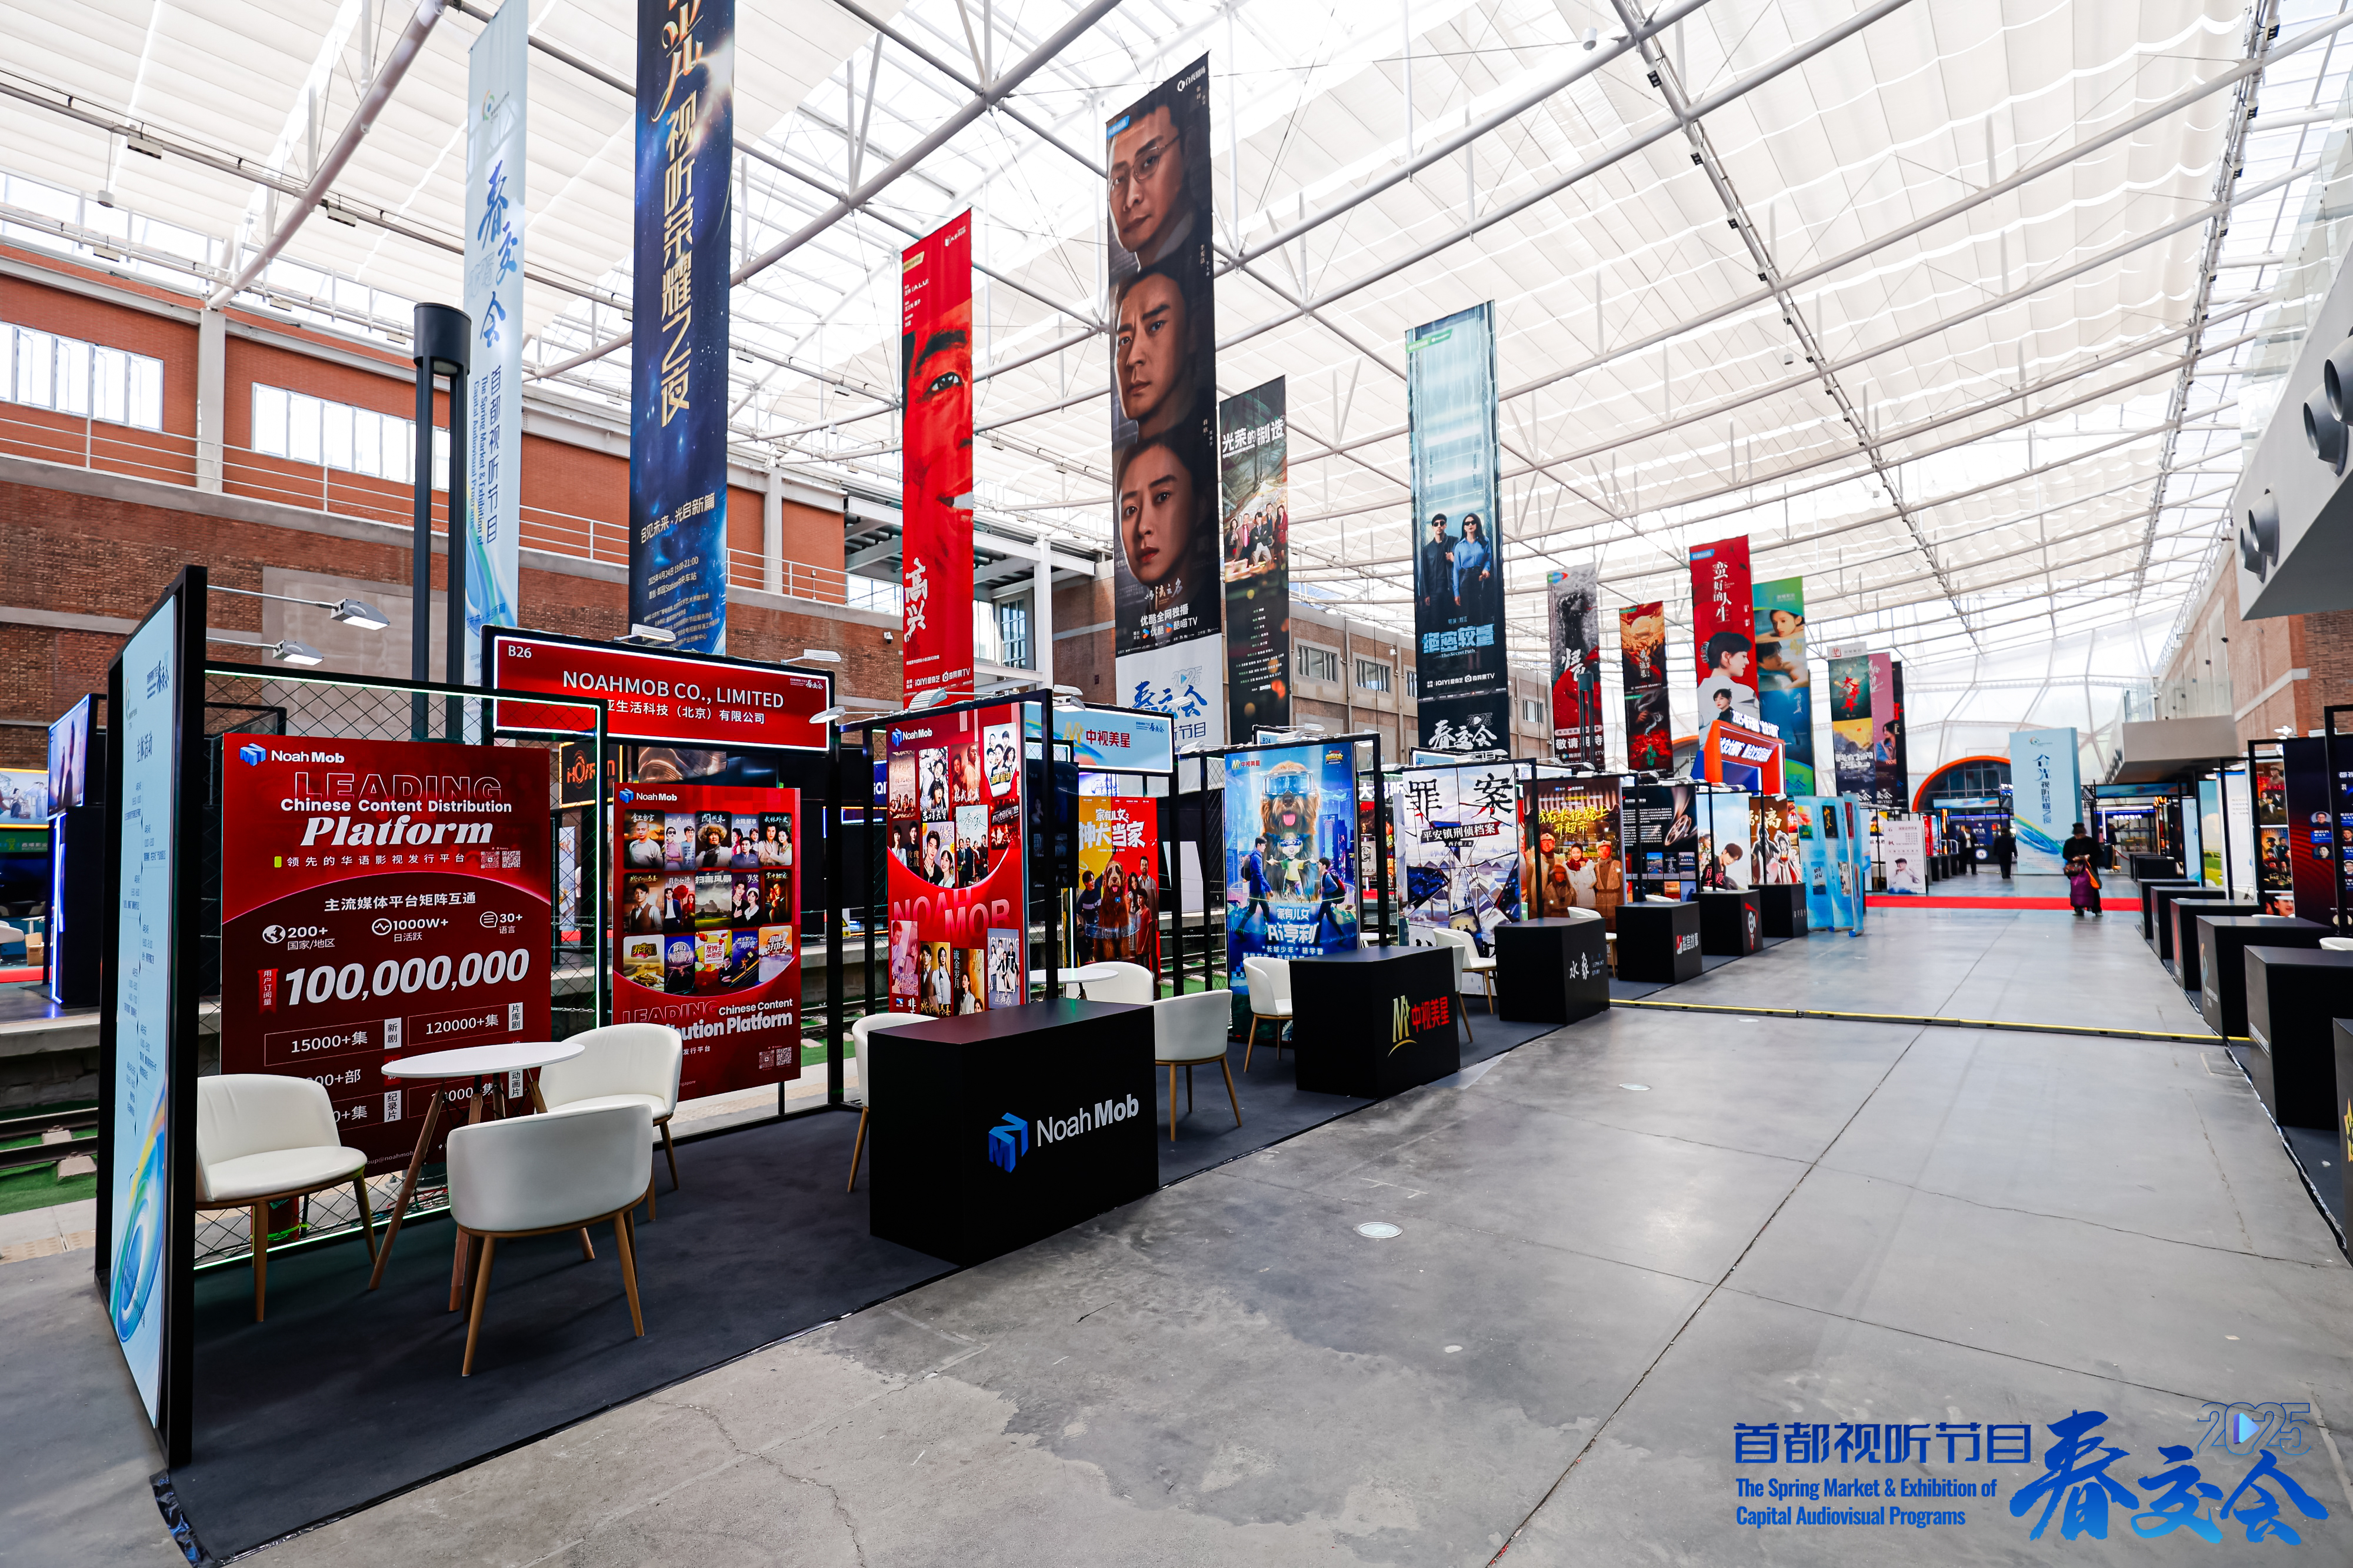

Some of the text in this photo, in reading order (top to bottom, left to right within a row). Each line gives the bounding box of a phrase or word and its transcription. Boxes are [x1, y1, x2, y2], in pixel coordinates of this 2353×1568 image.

[661, 90, 698, 428] 视听荣耀之夜
[479, 398, 488, 430] Spring
[488, 364, 501, 543] 首都视听节目
[477, 535, 484, 546] of
[905, 558, 927, 642] 高兴
[1712, 562, 1732, 622] 蛮好的人生
[1141, 603, 1188, 626] 优酷全网独播
[1151, 616, 1198, 637] 优酷 酷喵TV
[1423, 624, 1494, 653] 绝密较量
[508, 645, 532, 659] B26
[563, 671, 784, 708] NOAHMOB CO., LIMITED
[903, 728, 932, 740] NoahMob
[1086, 729, 1130, 748] 中视美星
[136, 730, 152, 763] 主体活动
[294, 772, 502, 800] LEADING
[1405, 772, 1515, 822] 罪案
[281, 798, 512, 813] Chinese Content Distribution
[300, 815, 493, 846] Platform
[1423, 823, 1496, 842] 平安镇刑侦档案
[1554, 821, 1588, 835] 开超市
[287, 853, 465, 867] 领先的华语影视发行平台
[325, 892, 476, 912] 主流媒体平台矩阵互通
[393, 918, 448, 930] 1000W+
[499, 913, 523, 923] 30+
[1277, 908, 1309, 921] 家有儿女
[288, 927, 328, 939] 200+
[394, 932, 422, 942] 日活跃
[499, 925, 516, 934] 语言
[288, 939, 335, 950] 国家/地区
[285, 948, 529, 1006] 100,000,000
[1569, 952, 1589, 980] 水象
[263, 970, 272, 1006] 用户订阅量
[512, 1005, 520, 1029] 片库剧
[719, 999, 792, 1016] Chinese Content
[1412, 996, 1449, 1033] 中视美星
[388, 1023, 398, 1043] 新剧
[426, 1014, 499, 1035] 120000+集
[727, 1010, 792, 1034] Platform
[291, 1031, 368, 1053] 15000+集
[388, 1093, 398, 1119] 纪录片
[1037, 1093, 1138, 1147] NoahMob
